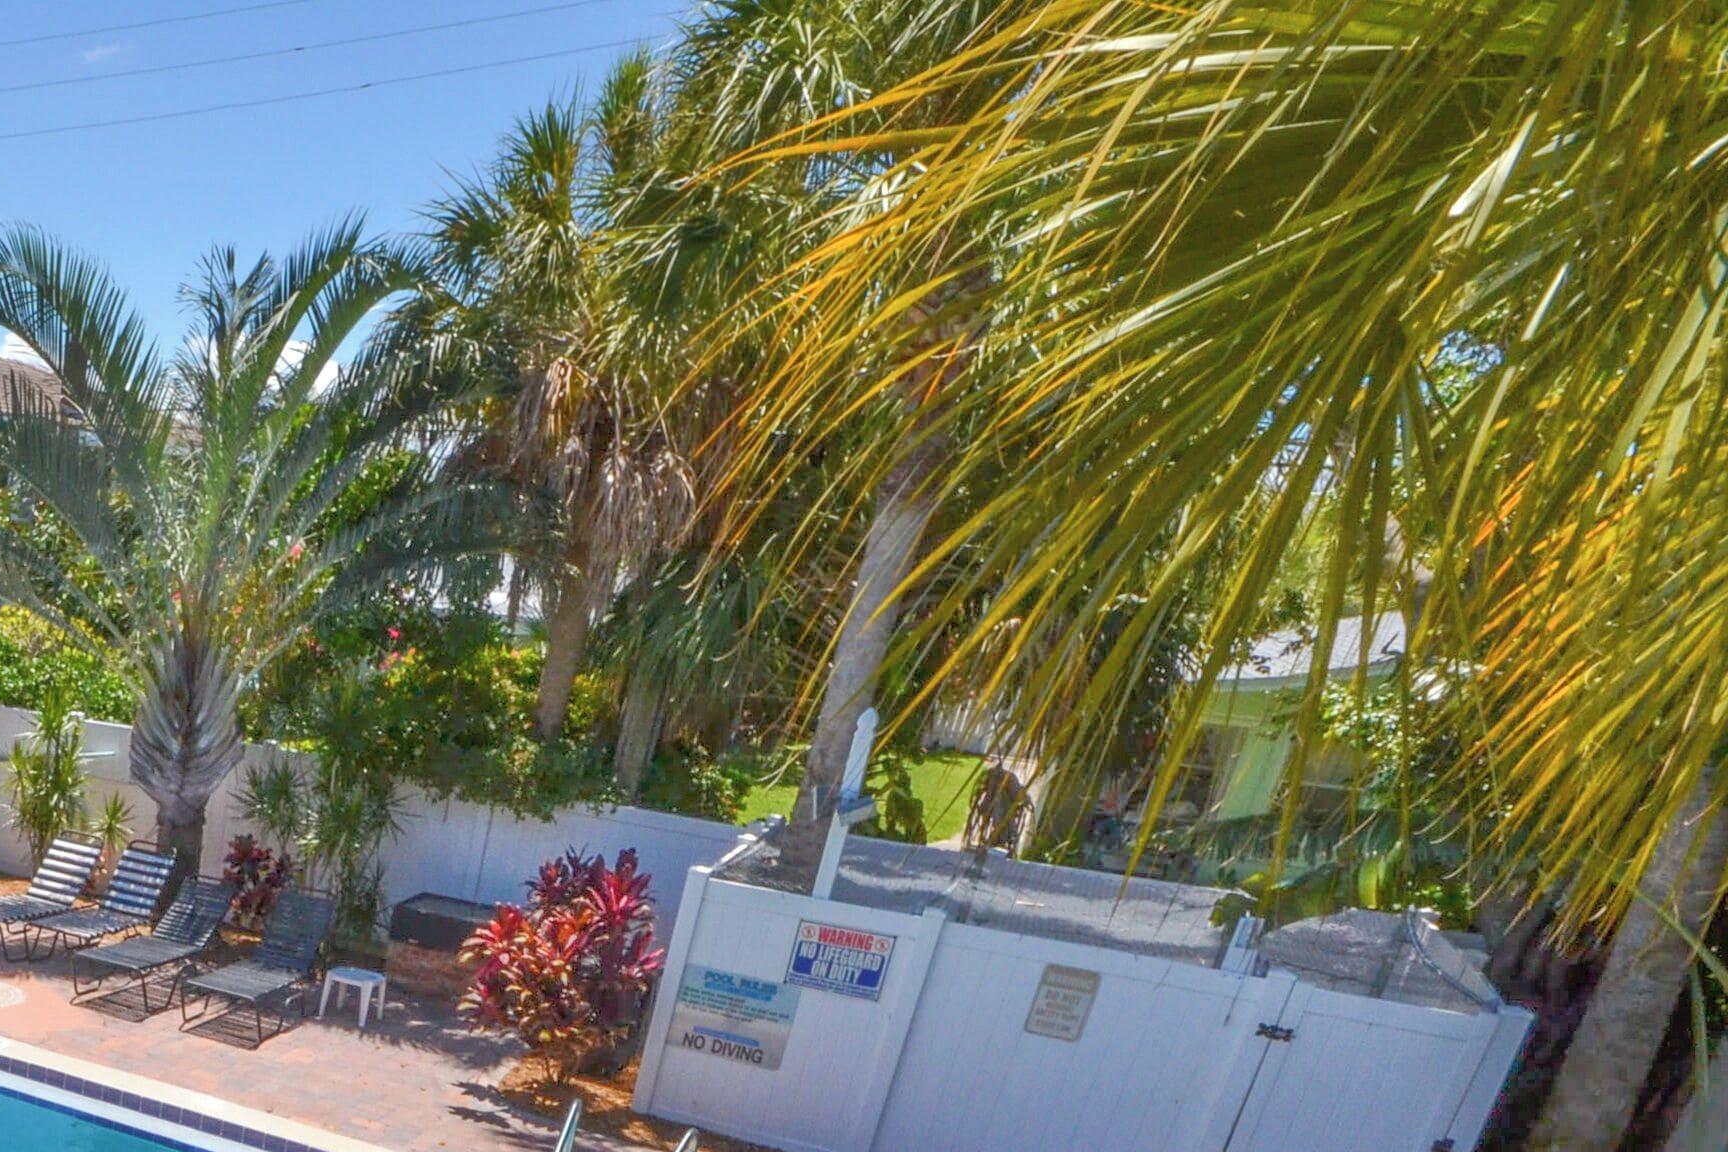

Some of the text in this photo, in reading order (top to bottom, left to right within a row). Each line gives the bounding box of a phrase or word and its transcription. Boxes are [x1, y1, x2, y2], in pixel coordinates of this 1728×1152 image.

[818, 926, 874, 951] WARNING
[799, 942, 881, 972] NO LIFEGUARD
[704, 970, 735, 985] POOL
[811, 960, 862, 984] ON DUTY
[683, 1032, 706, 1050] NO
[711, 1039, 764, 1064] DIVING
